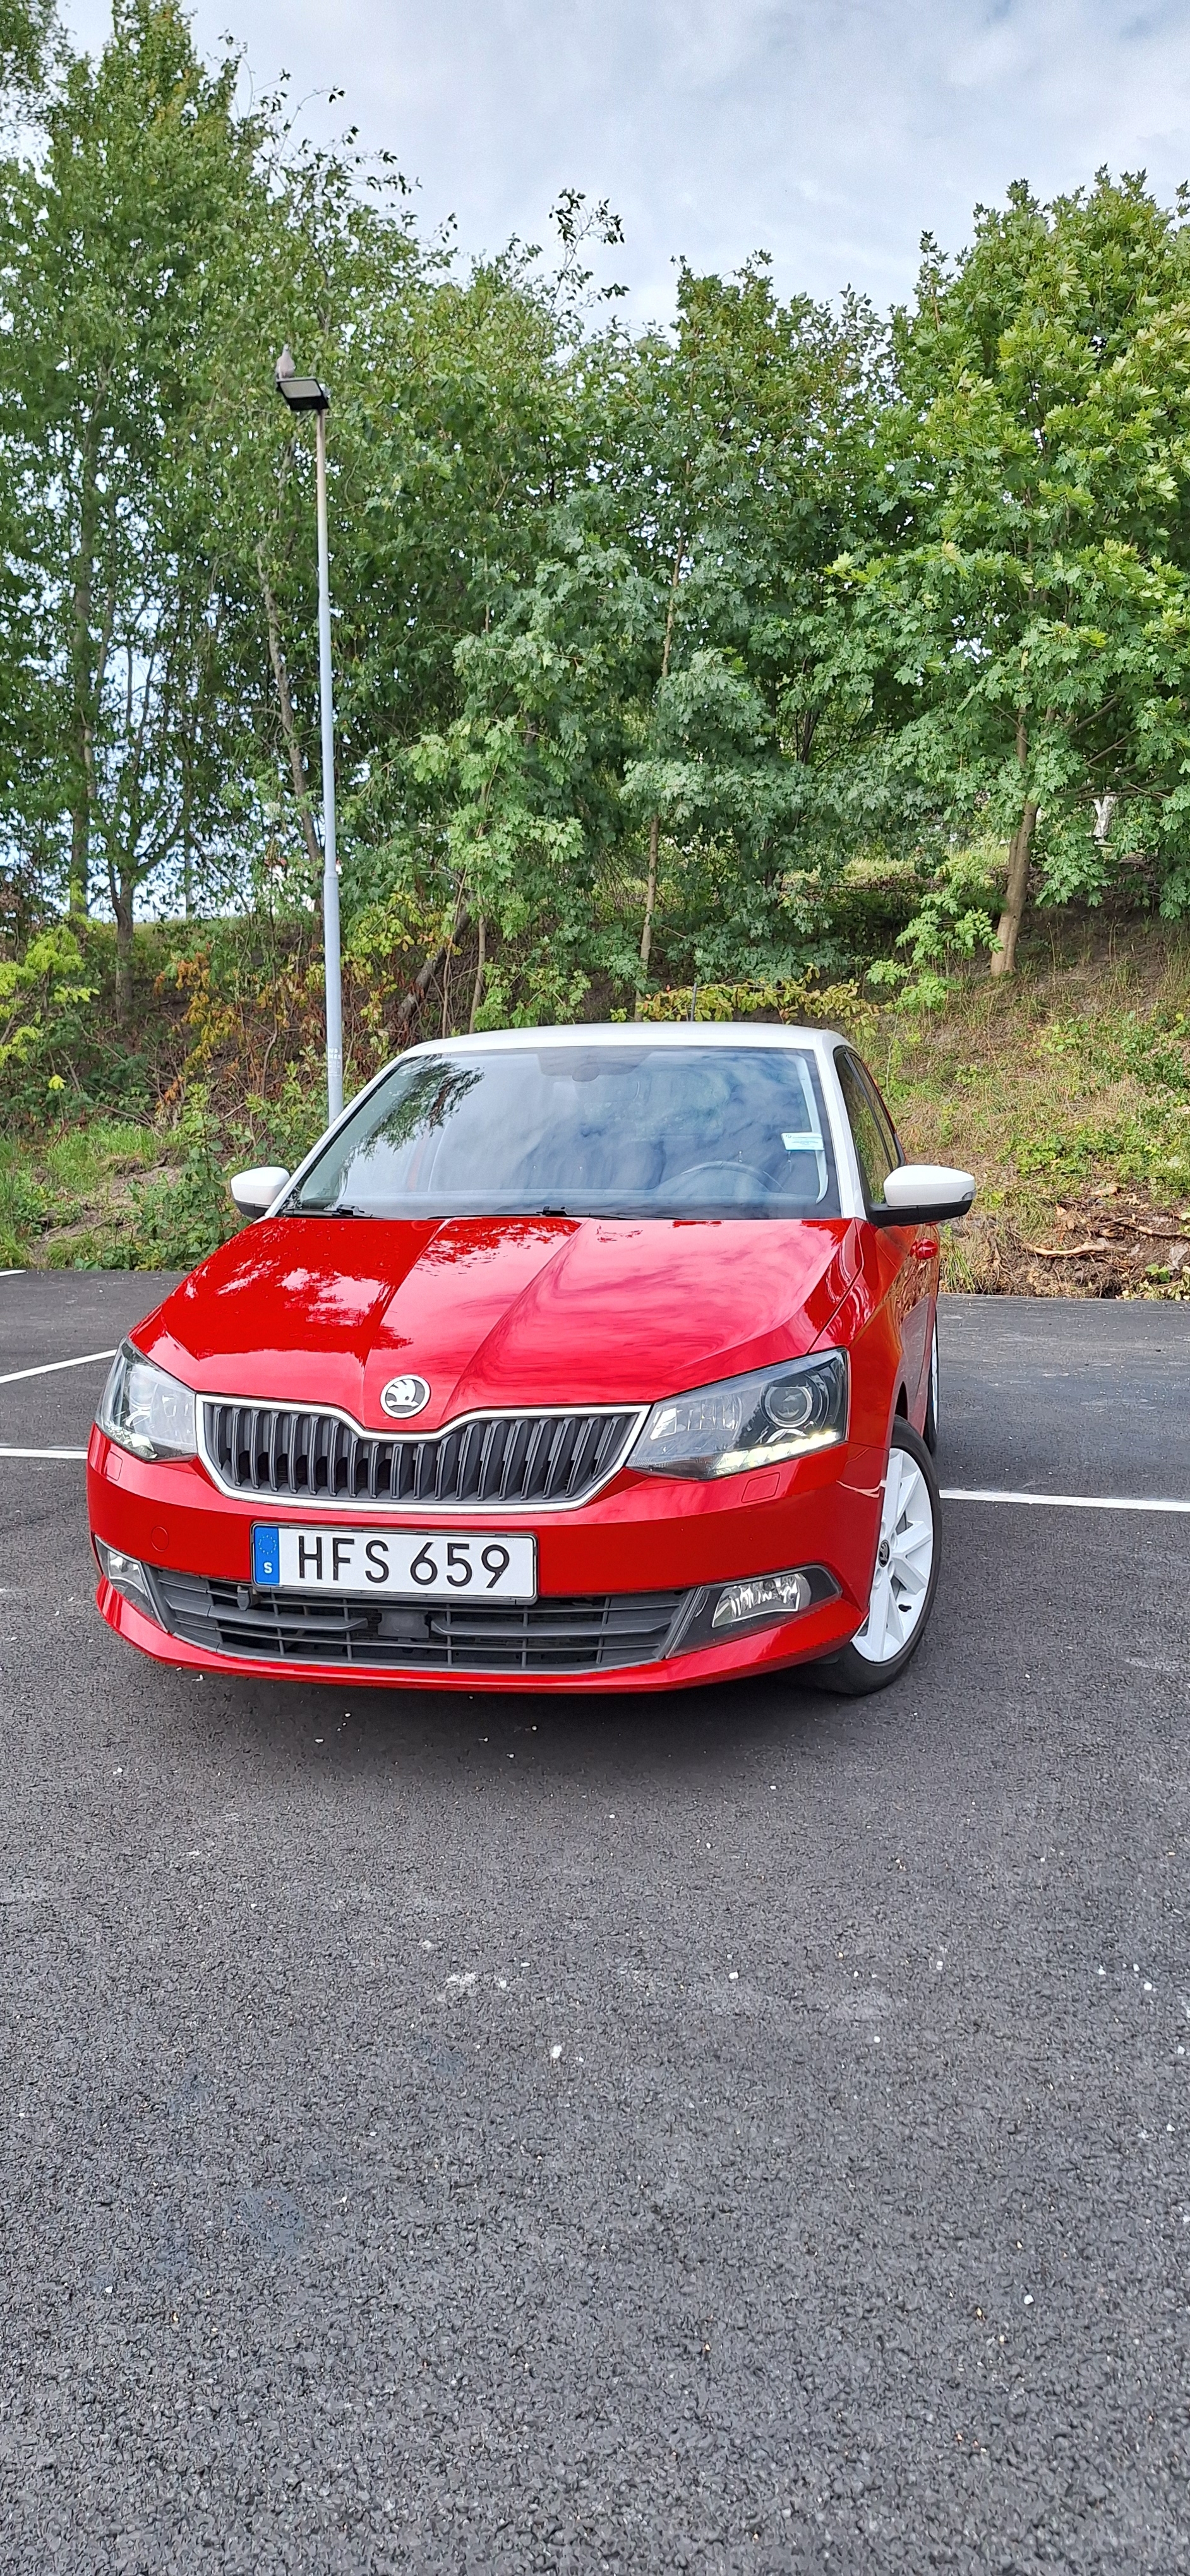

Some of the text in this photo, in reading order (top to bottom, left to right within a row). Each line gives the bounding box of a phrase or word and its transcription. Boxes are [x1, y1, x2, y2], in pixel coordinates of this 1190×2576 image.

[263, 1562, 273, 1574] S
[298, 1535, 510, 1589] HFS 659
